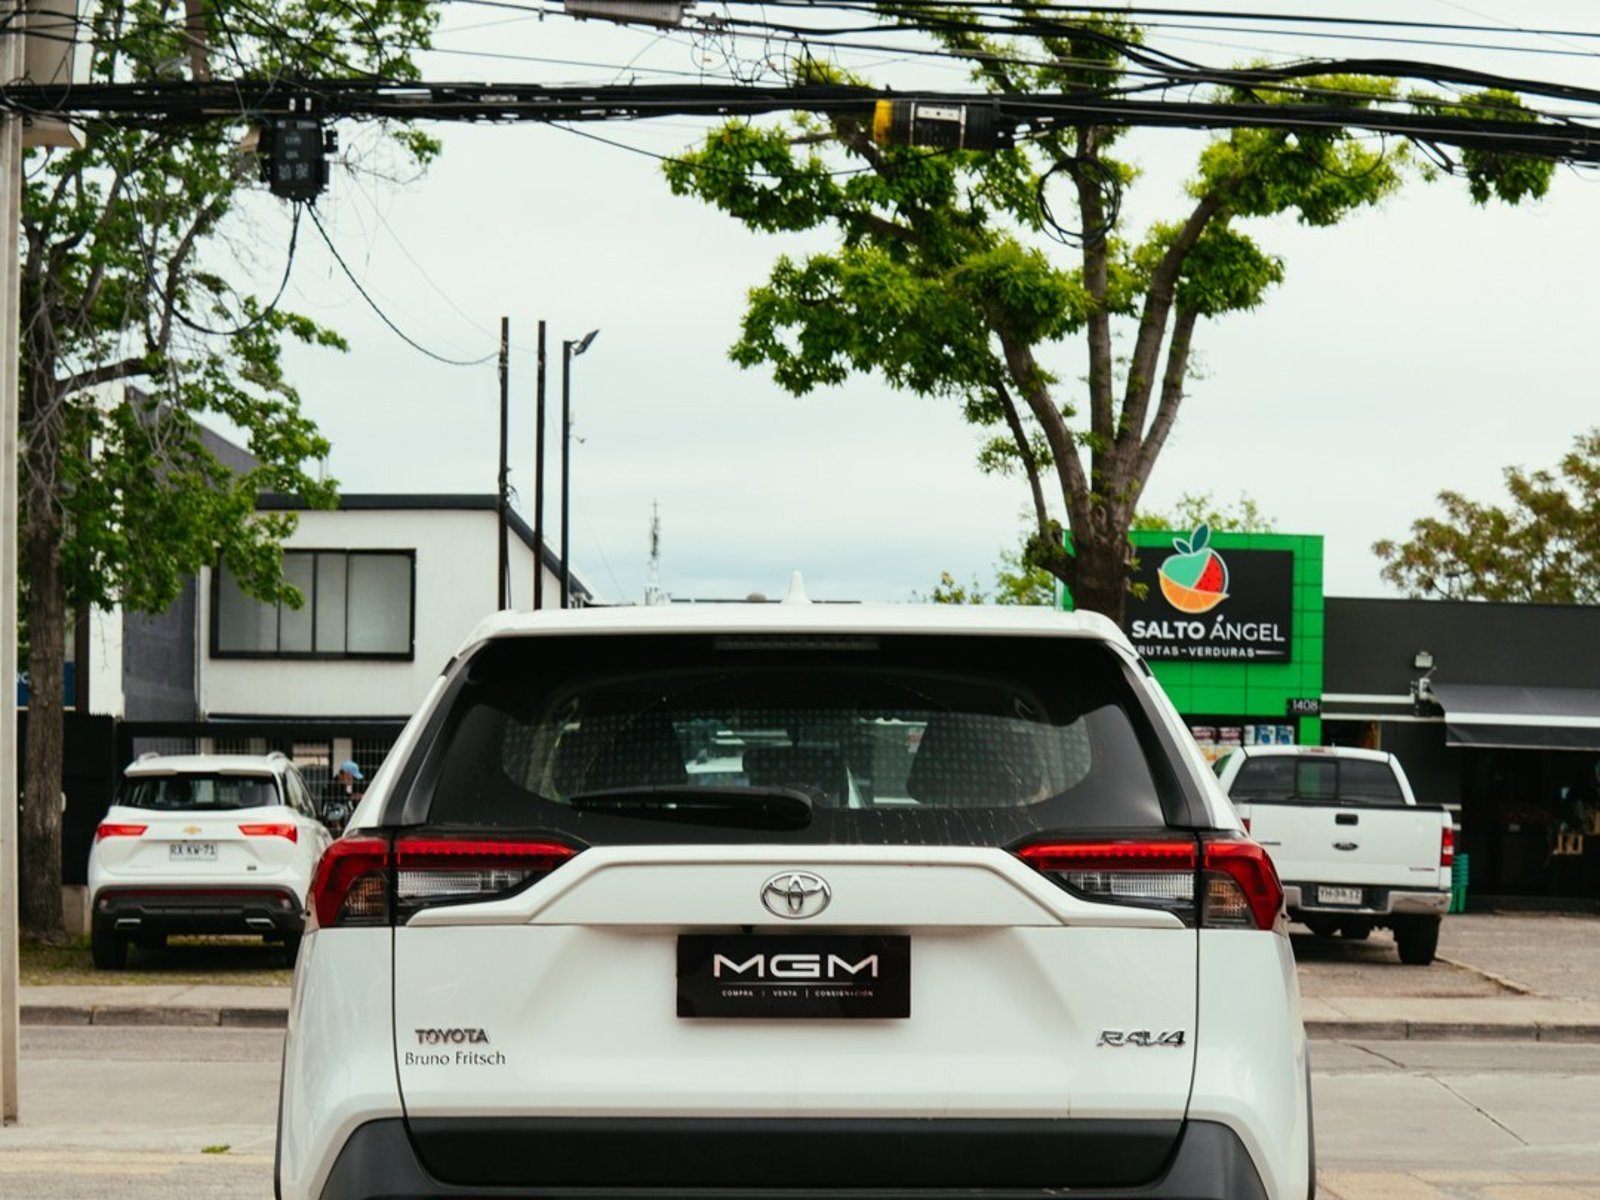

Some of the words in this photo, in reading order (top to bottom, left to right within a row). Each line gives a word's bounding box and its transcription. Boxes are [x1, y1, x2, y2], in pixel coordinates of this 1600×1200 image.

[1131, 620, 1206, 640] SALTO
[1209, 614, 1286, 642] ÁNGEL
[1292, 698, 1318, 712] 1408
[713, 953, 879, 979] MGM
[722, 989, 754, 998] COMPRA
[773, 989, 798, 998] VENTA
[414, 1028, 490, 1045] TOYOTA
[1096, 1029, 1186, 1048] RAV4
[404, 1051, 451, 1066] Bruno
[455, 1050, 506, 1066] Fritsch
